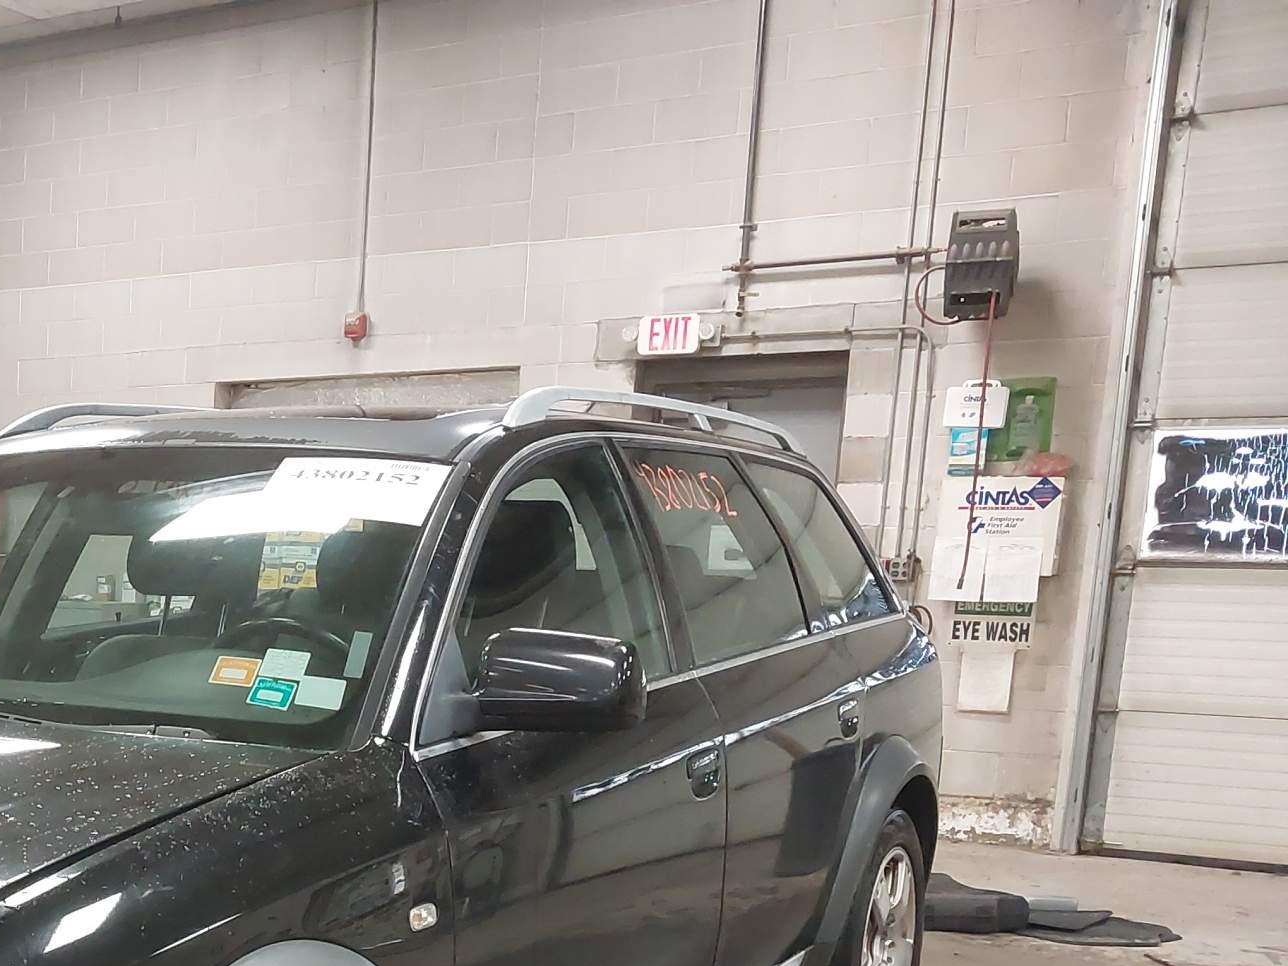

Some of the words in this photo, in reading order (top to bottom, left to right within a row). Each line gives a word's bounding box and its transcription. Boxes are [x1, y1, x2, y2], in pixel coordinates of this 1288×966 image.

[648, 316, 692, 351] EXIT
[289, 468, 421, 486] 43802152
[632, 460, 738, 516] 43802152
[957, 601, 1031, 613] EMERGENCY
[952, 620, 981, 641] EYE
[986, 621, 1031, 643] WASH
